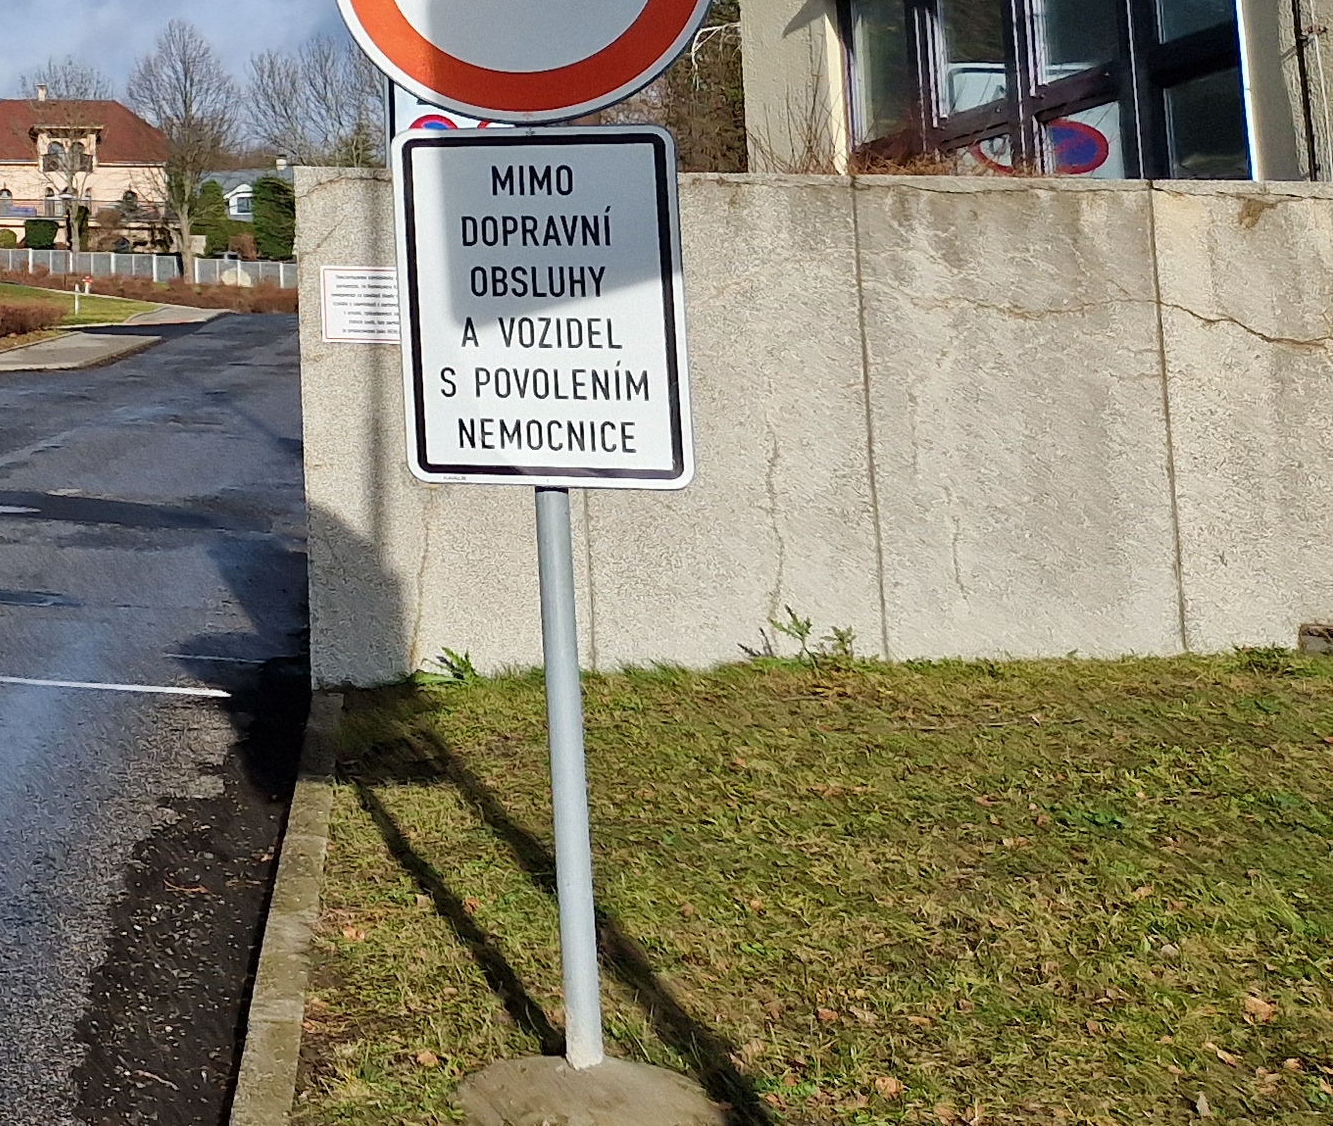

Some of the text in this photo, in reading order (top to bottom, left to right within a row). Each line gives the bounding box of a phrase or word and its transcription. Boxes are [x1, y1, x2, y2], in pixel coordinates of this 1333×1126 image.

[491, 164, 573, 196] MIMO
[461, 206, 612, 247] DOPRAVNÍ
[470, 265, 606, 298] OBSLUHY
[461, 317, 623, 350] A VOZIDEL
[440, 360, 650, 402] S POVOLENÍM
[458, 417, 637, 454] NEMOCNICE
